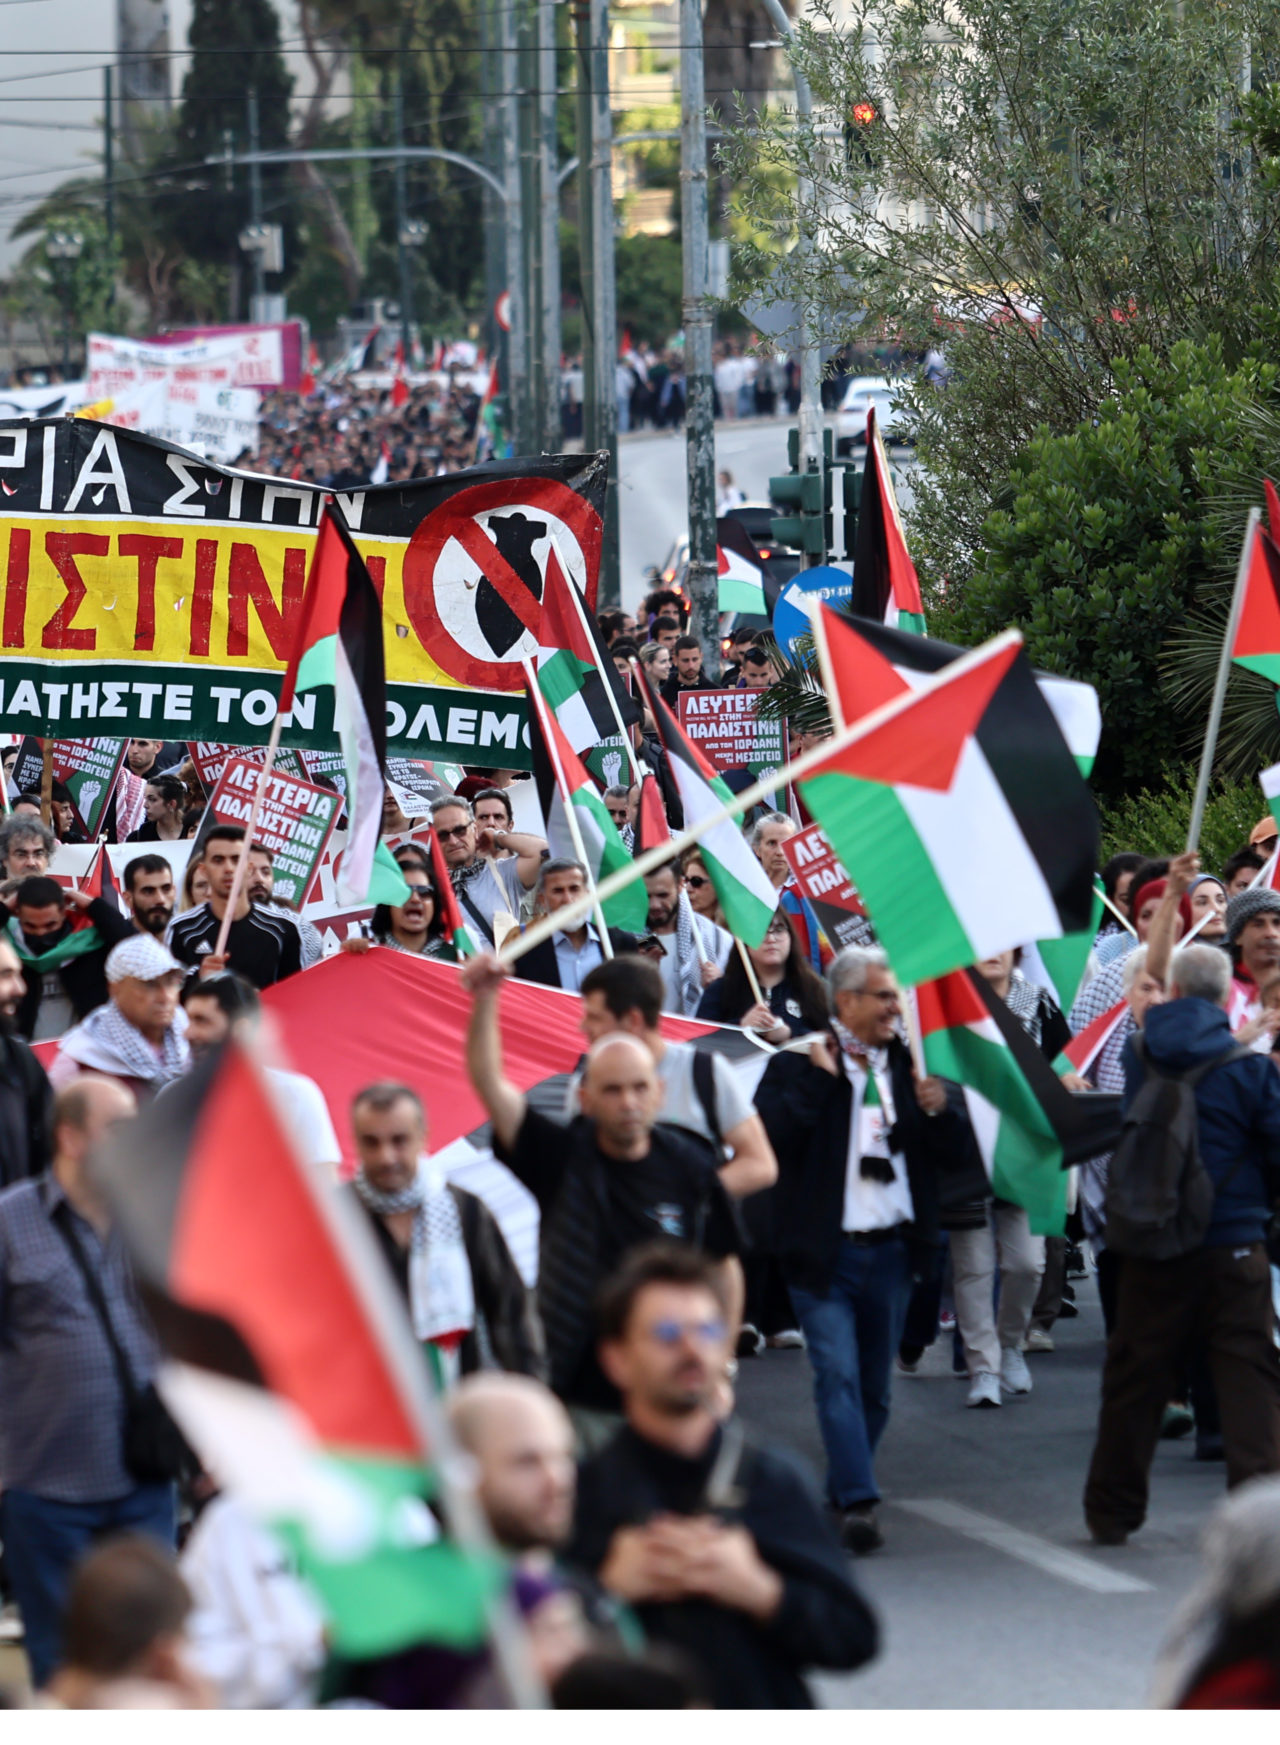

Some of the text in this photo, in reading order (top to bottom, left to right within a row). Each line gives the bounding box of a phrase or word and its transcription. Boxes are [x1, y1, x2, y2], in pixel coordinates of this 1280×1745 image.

[686, 693, 762, 715] ΛΕΥΤΕΡ
[210, 687, 317, 730] ΤΟΝ
[333, 692, 532, 750] ΟΛΕΜ
[719, 713, 742, 721] ΣΤΗΝ
[686, 720, 780, 739] ΠΑΛΑΙΣΤΙΝΗ
[734, 738, 780, 750] ΙΟΡΔΑΝΗ
[71, 745, 115, 768] ΙΟΡΔΑΝΗ
[735, 750, 781, 763] ΜΕΣΟΓΕΙΟ
[67, 758, 112, 780] ΜΕΣΟΓΕΙΟ
[227, 765, 332, 820] ΛΕΥΤΕΡΙΑ
[215, 794, 323, 848] ΠΑΛΑΙΣΤΙΝΗ
[262, 833, 315, 863] ΙΟΡΔΑΝΗ
